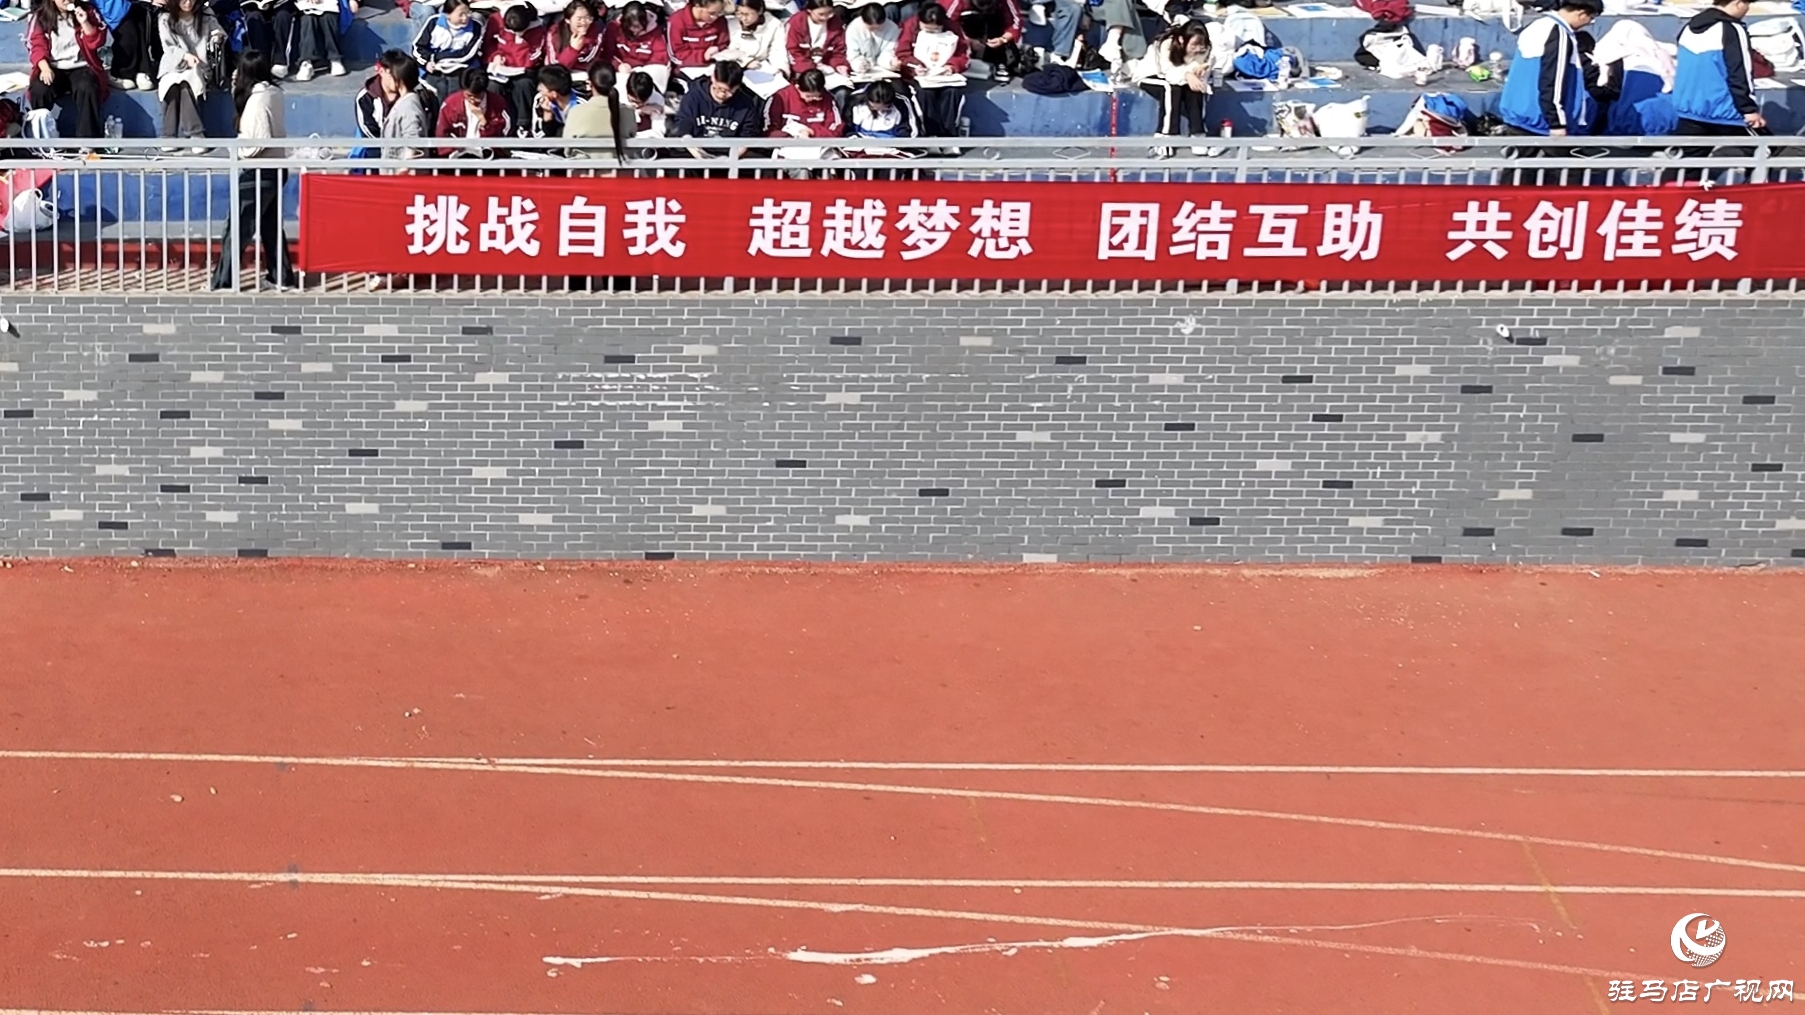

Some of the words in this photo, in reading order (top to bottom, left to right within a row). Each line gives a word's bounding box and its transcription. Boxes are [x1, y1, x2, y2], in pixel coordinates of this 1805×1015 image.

[405, 194, 687, 258] 挑战自我
[747, 198, 1033, 261] 超越梦想
[1097, 200, 1383, 262] 团结互助
[1445, 198, 1743, 262] 共创佳绩
